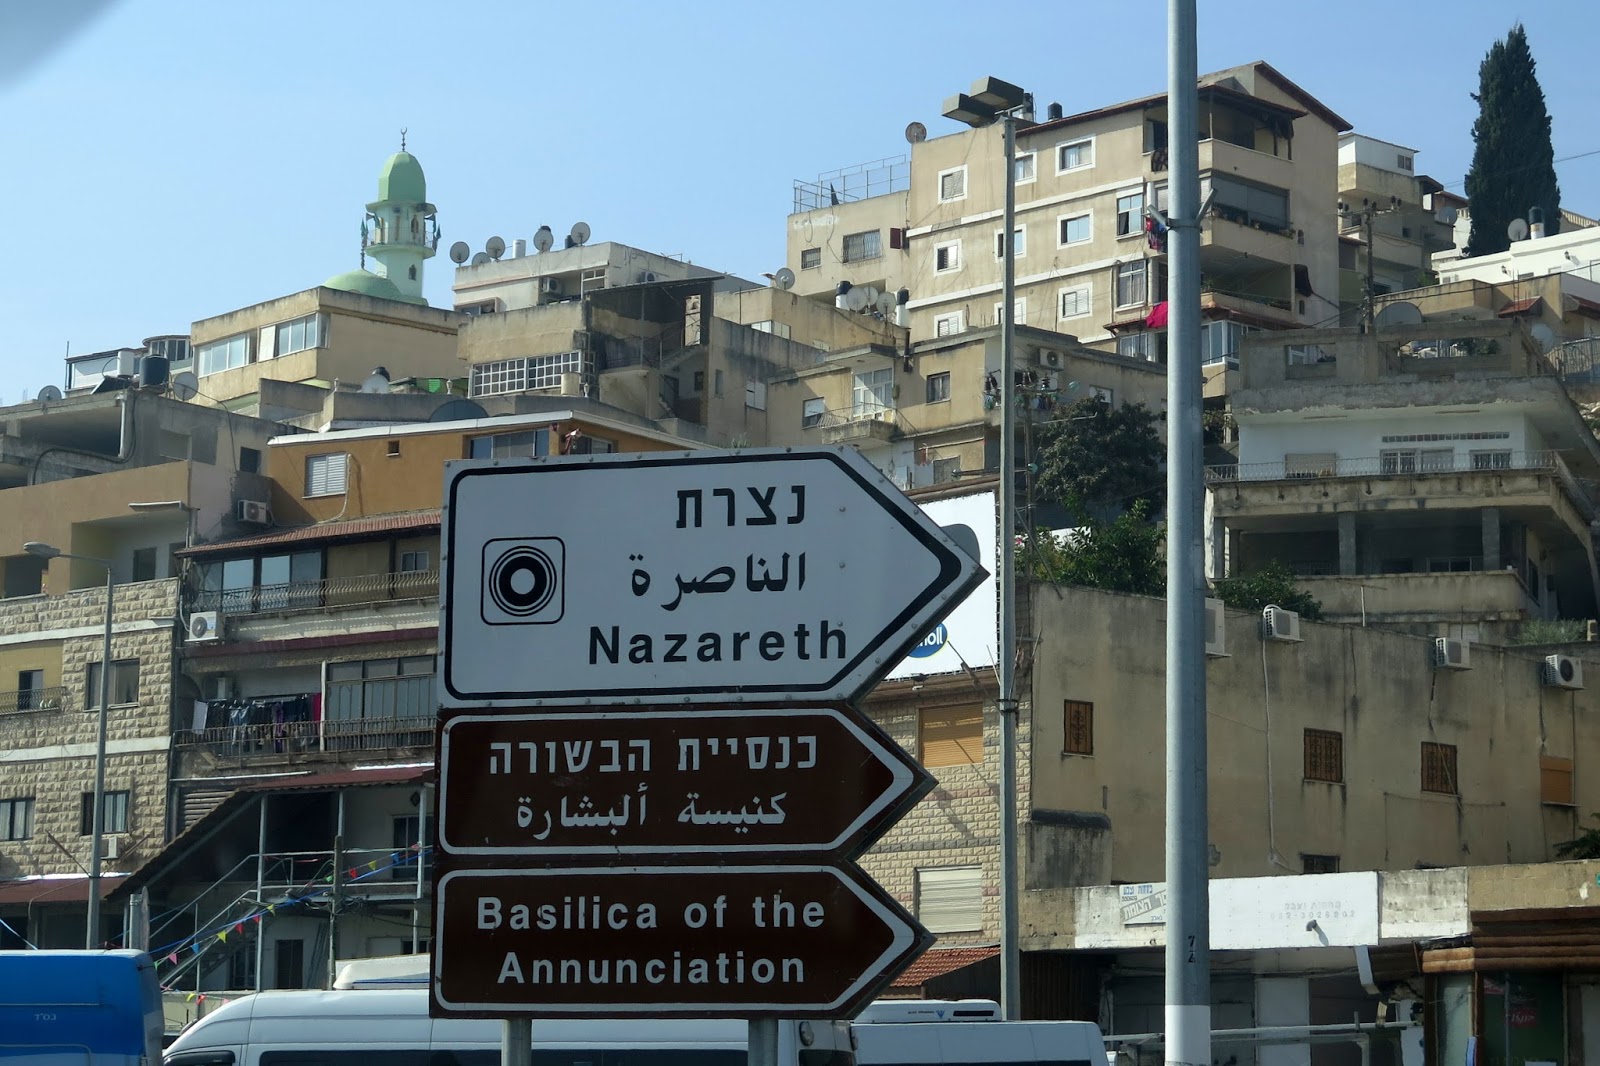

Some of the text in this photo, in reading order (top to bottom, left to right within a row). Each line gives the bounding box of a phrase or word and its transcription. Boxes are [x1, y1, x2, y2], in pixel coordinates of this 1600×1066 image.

[676, 485, 806, 528] נצרת
[629, 552, 806, 610] الناصرة
[589, 620, 847, 665] Nazareth
[490, 736, 817, 774] כנסיית הבשורה
[678, 792, 787, 834] كنيسة
[477, 894, 825, 930] Basilica of the
[497, 951, 804, 984] Annunciation
